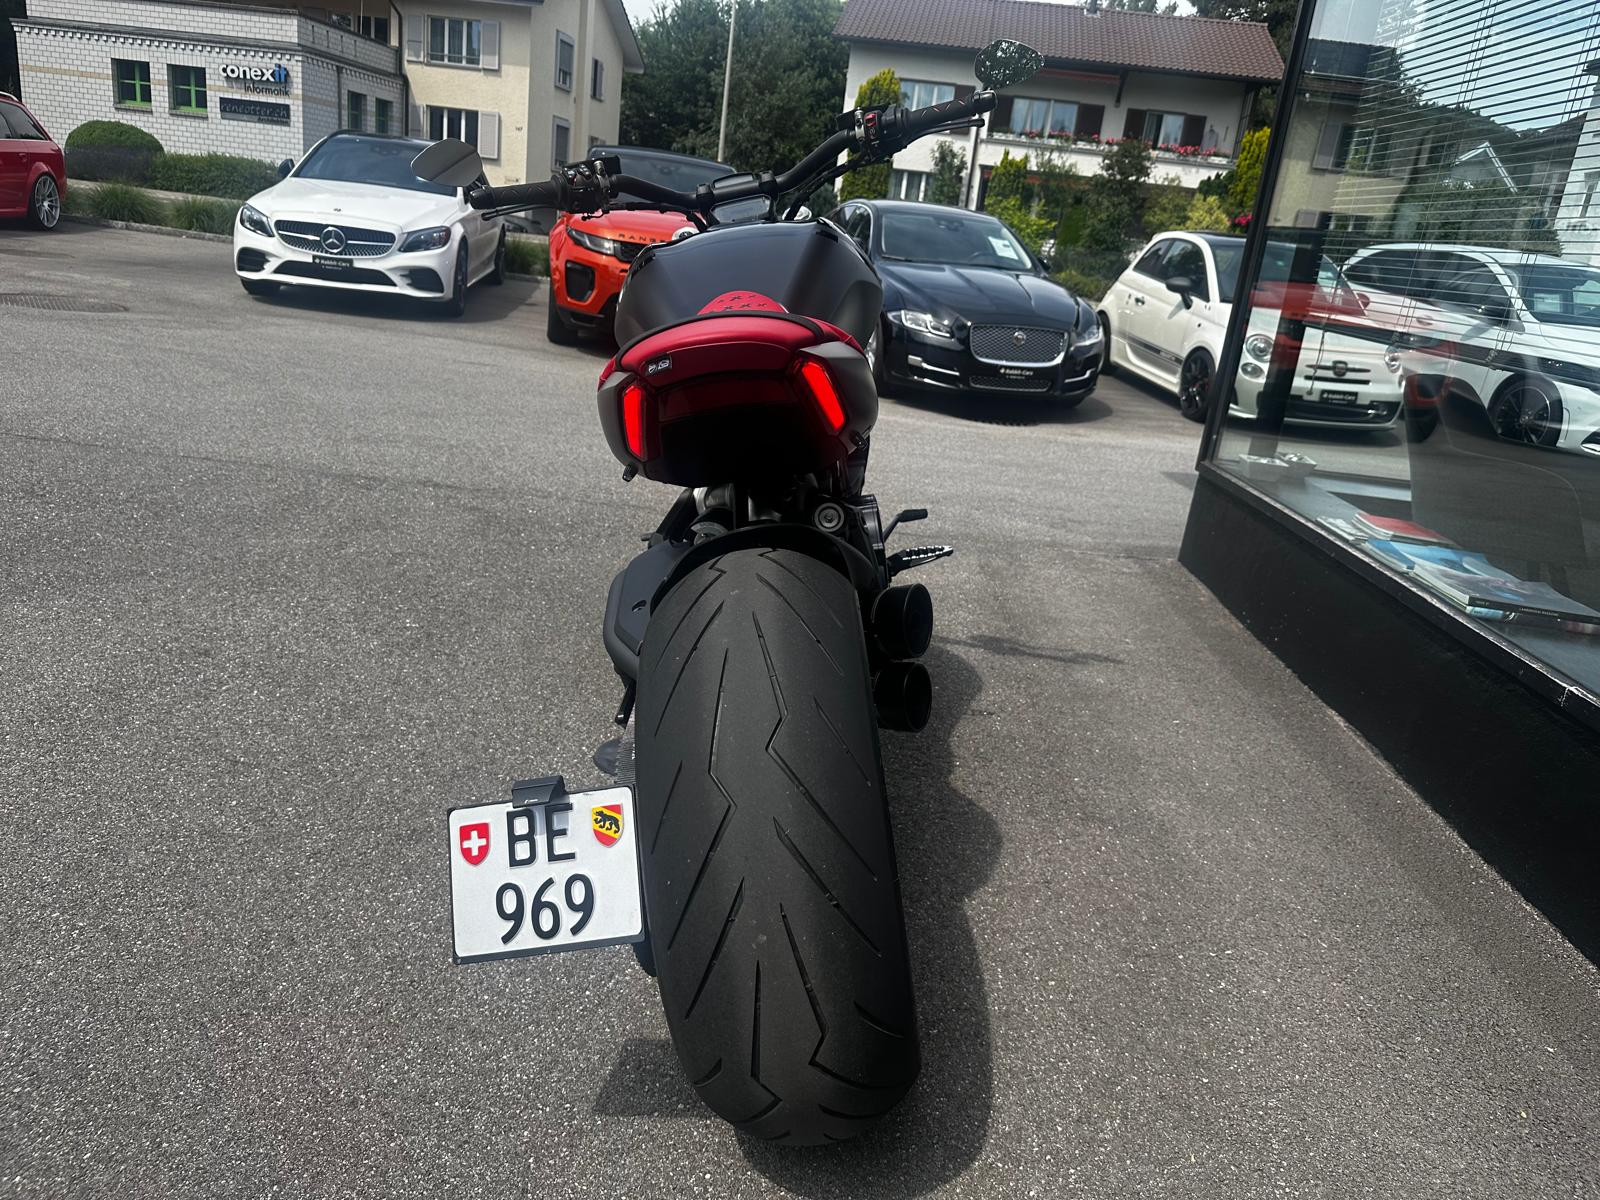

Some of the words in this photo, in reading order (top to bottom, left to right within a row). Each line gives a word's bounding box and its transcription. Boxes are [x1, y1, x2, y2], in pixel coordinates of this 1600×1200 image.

[219, 63, 286, 82] conexit
[244, 81, 290, 97] Informatik
[506, 803, 576, 867] BE
[495, 873, 594, 945] 969
